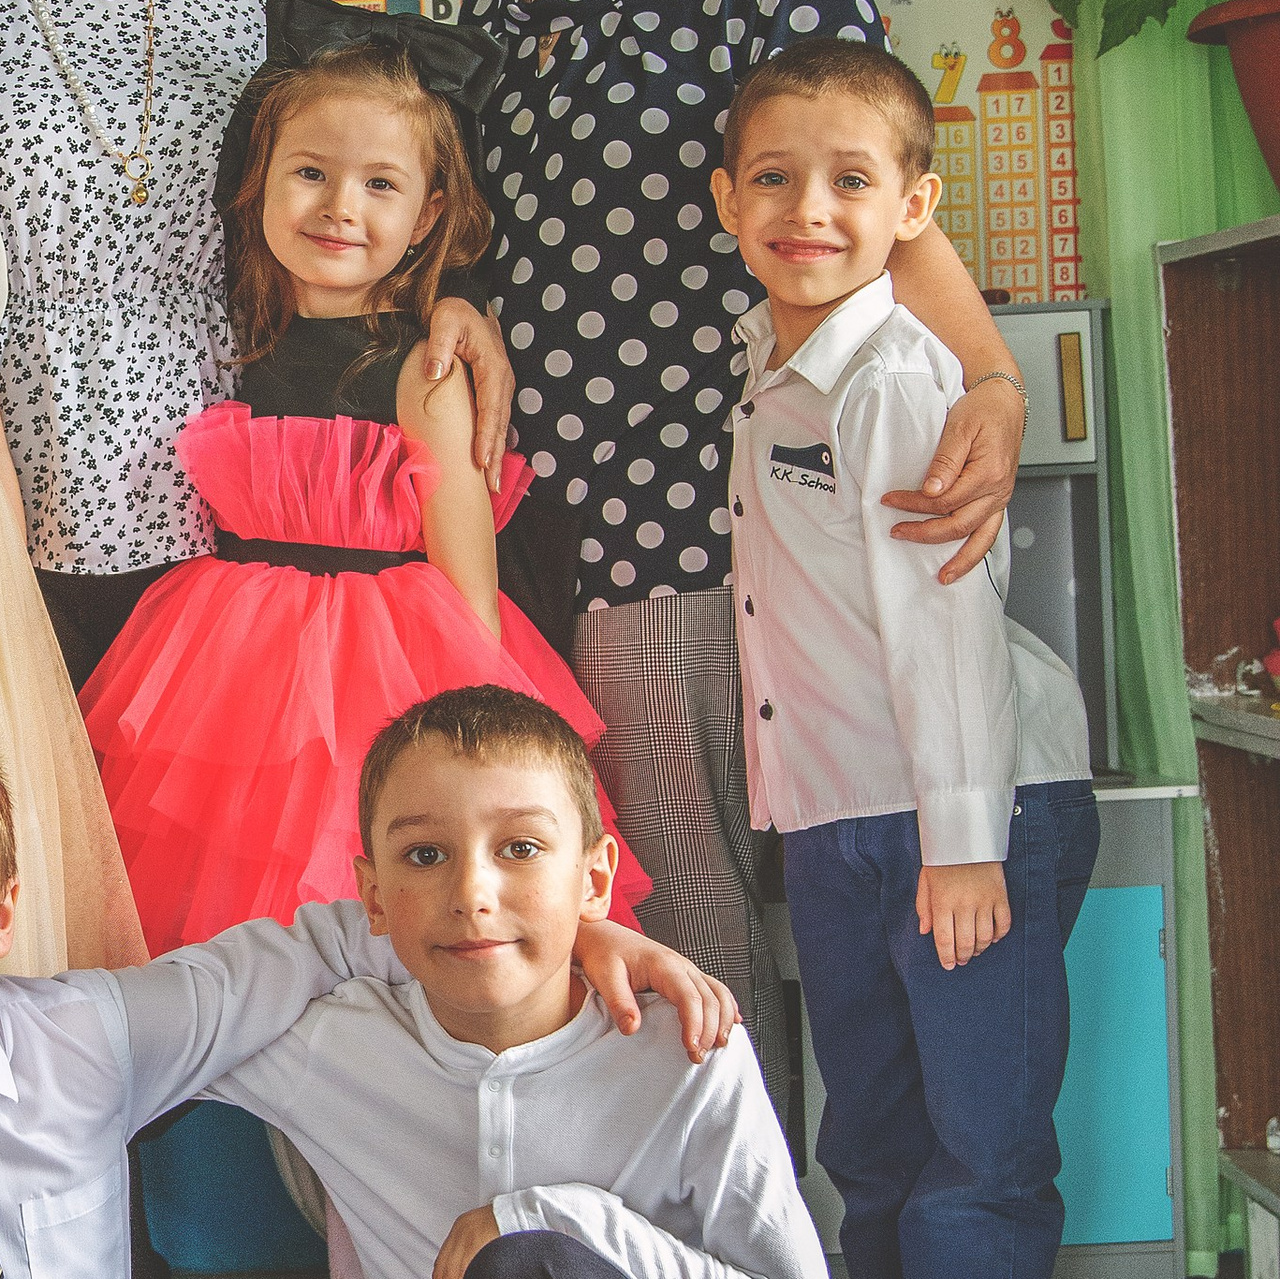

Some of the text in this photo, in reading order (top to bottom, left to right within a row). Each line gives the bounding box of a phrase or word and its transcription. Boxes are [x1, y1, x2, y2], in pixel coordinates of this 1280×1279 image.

[987, 15, 1027, 70] 8
[931, 52, 967, 104] 7
[1053, 66, 1063, 82] 1
[992, 97, 1025, 114] 1 7
[1054, 95, 1065, 110] 2
[992, 125, 1027, 142] 2 6
[1055, 123, 1066, 140] 3
[993, 154, 1028, 171] 3 5
[1056, 152, 1067, 168] 4
[994, 182, 1028, 200] 4 4
[1057, 180, 1068, 196] 5
[996, 210, 1030, 229] 5 3
[1058, 208, 1070, 225] 6
[996, 238, 1031, 256] 6 2
[1060, 238, 1070, 253] 7
[997, 268, 1030, 286] 7 1
[1060, 266, 1071, 282] 8
